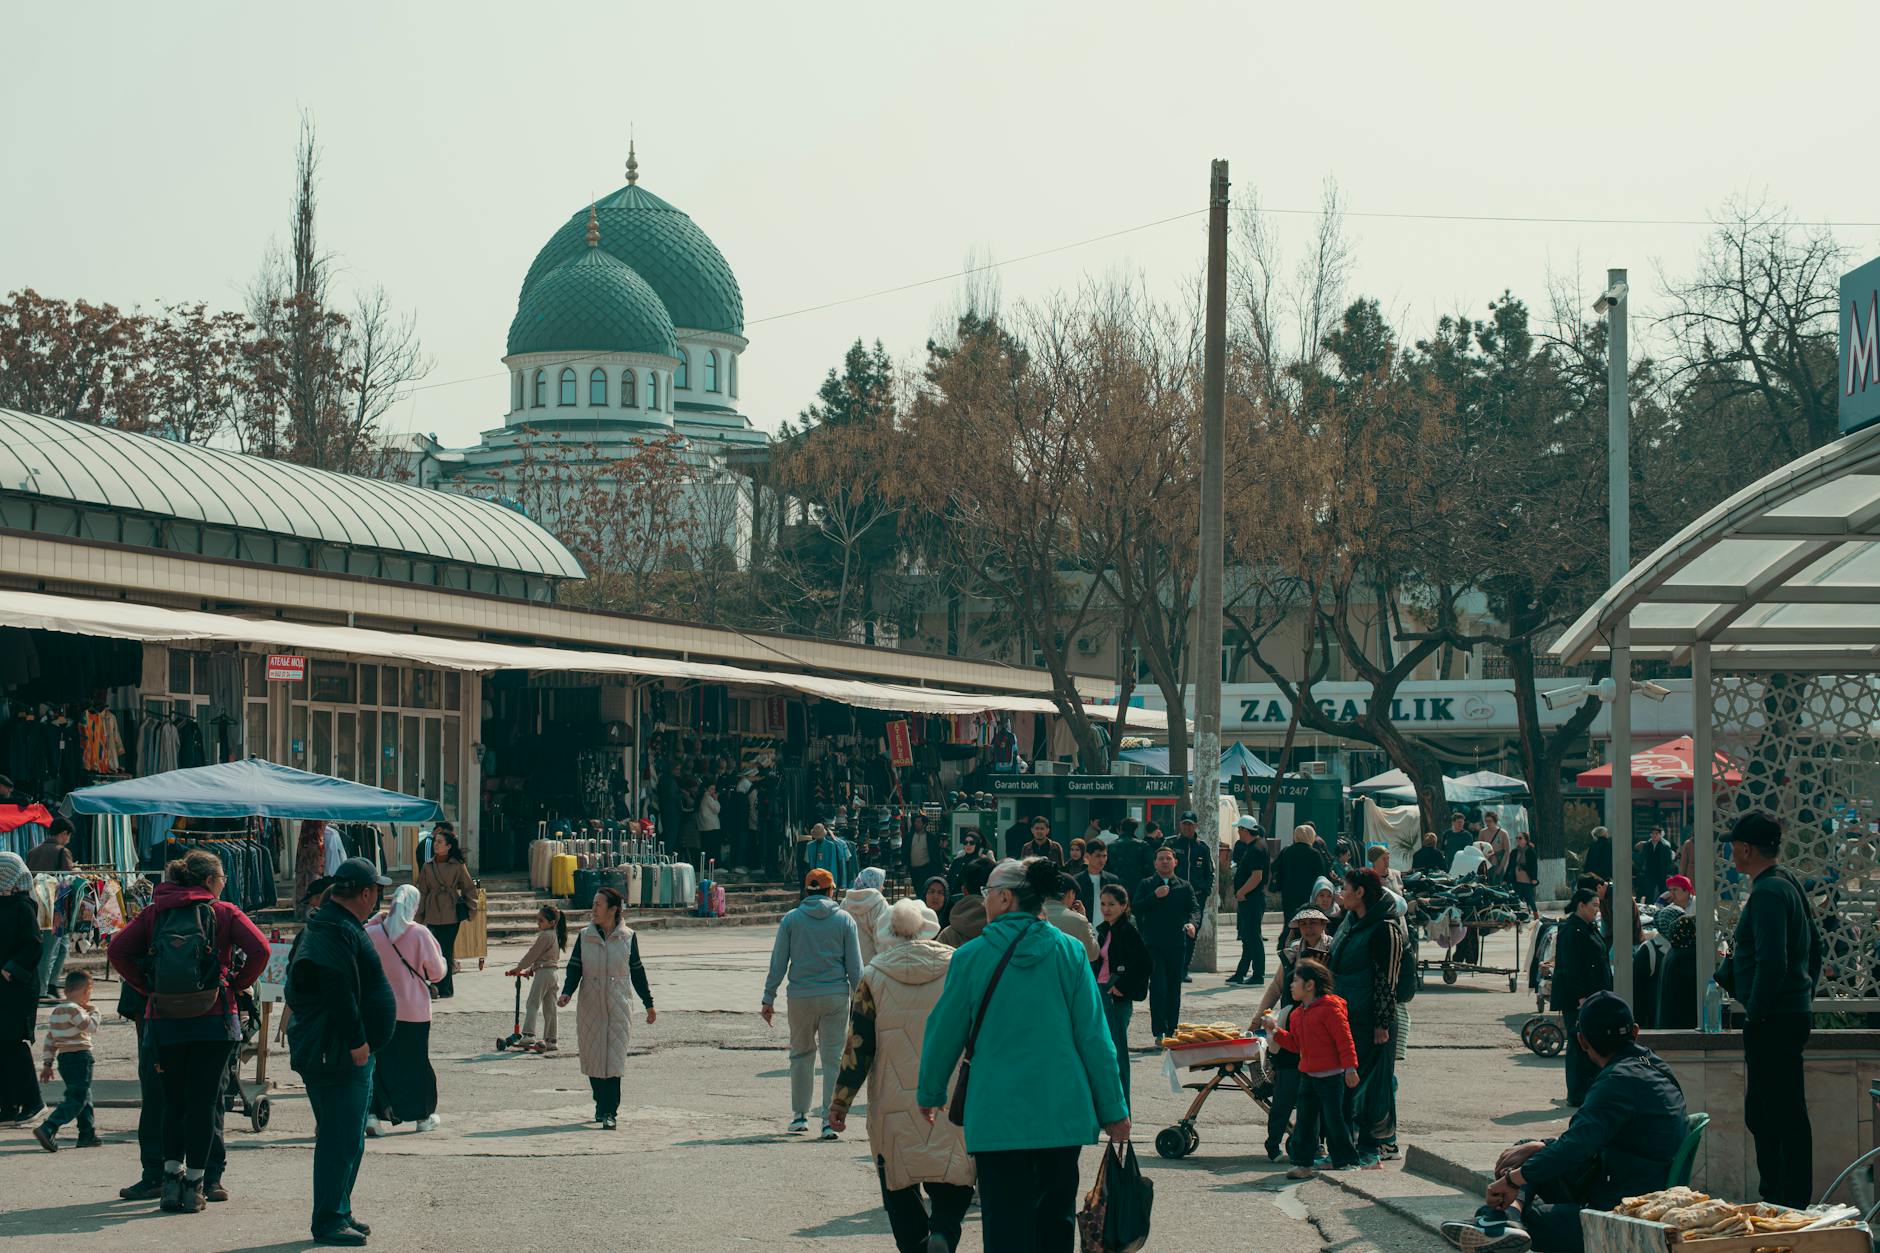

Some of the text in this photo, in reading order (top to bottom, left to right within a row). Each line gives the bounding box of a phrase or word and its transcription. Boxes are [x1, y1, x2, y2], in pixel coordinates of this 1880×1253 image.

[1240, 698, 1455, 722] ZAGALIK
[994, 780, 1039, 790] Garant bank
[1068, 780, 1114, 791] Garant bank
[1145, 781, 1173, 791] ATM 24/7
[1289, 786, 1309, 796] 24/7
